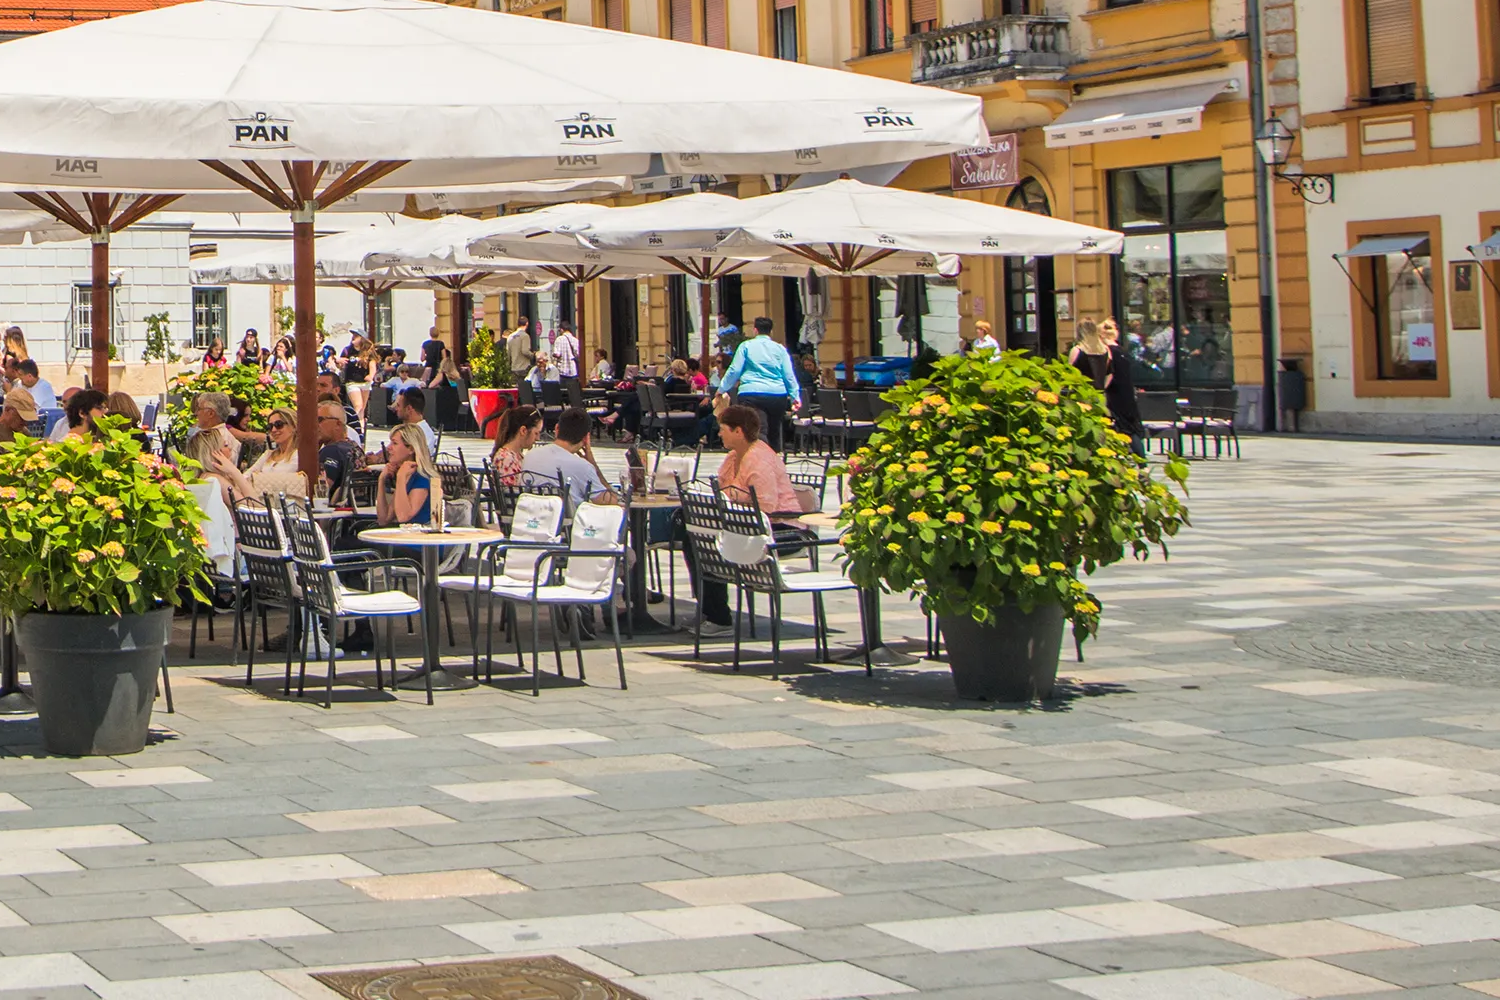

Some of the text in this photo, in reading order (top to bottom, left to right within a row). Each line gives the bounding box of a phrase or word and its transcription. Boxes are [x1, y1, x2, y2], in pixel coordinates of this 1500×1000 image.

[864, 116, 914, 127] PAN
[236, 125, 288, 142] PAN
[563, 124, 614, 139] PAN
[988, 141, 1010, 153] SLIKA
[961, 159, 1007, 184] Sabolić
